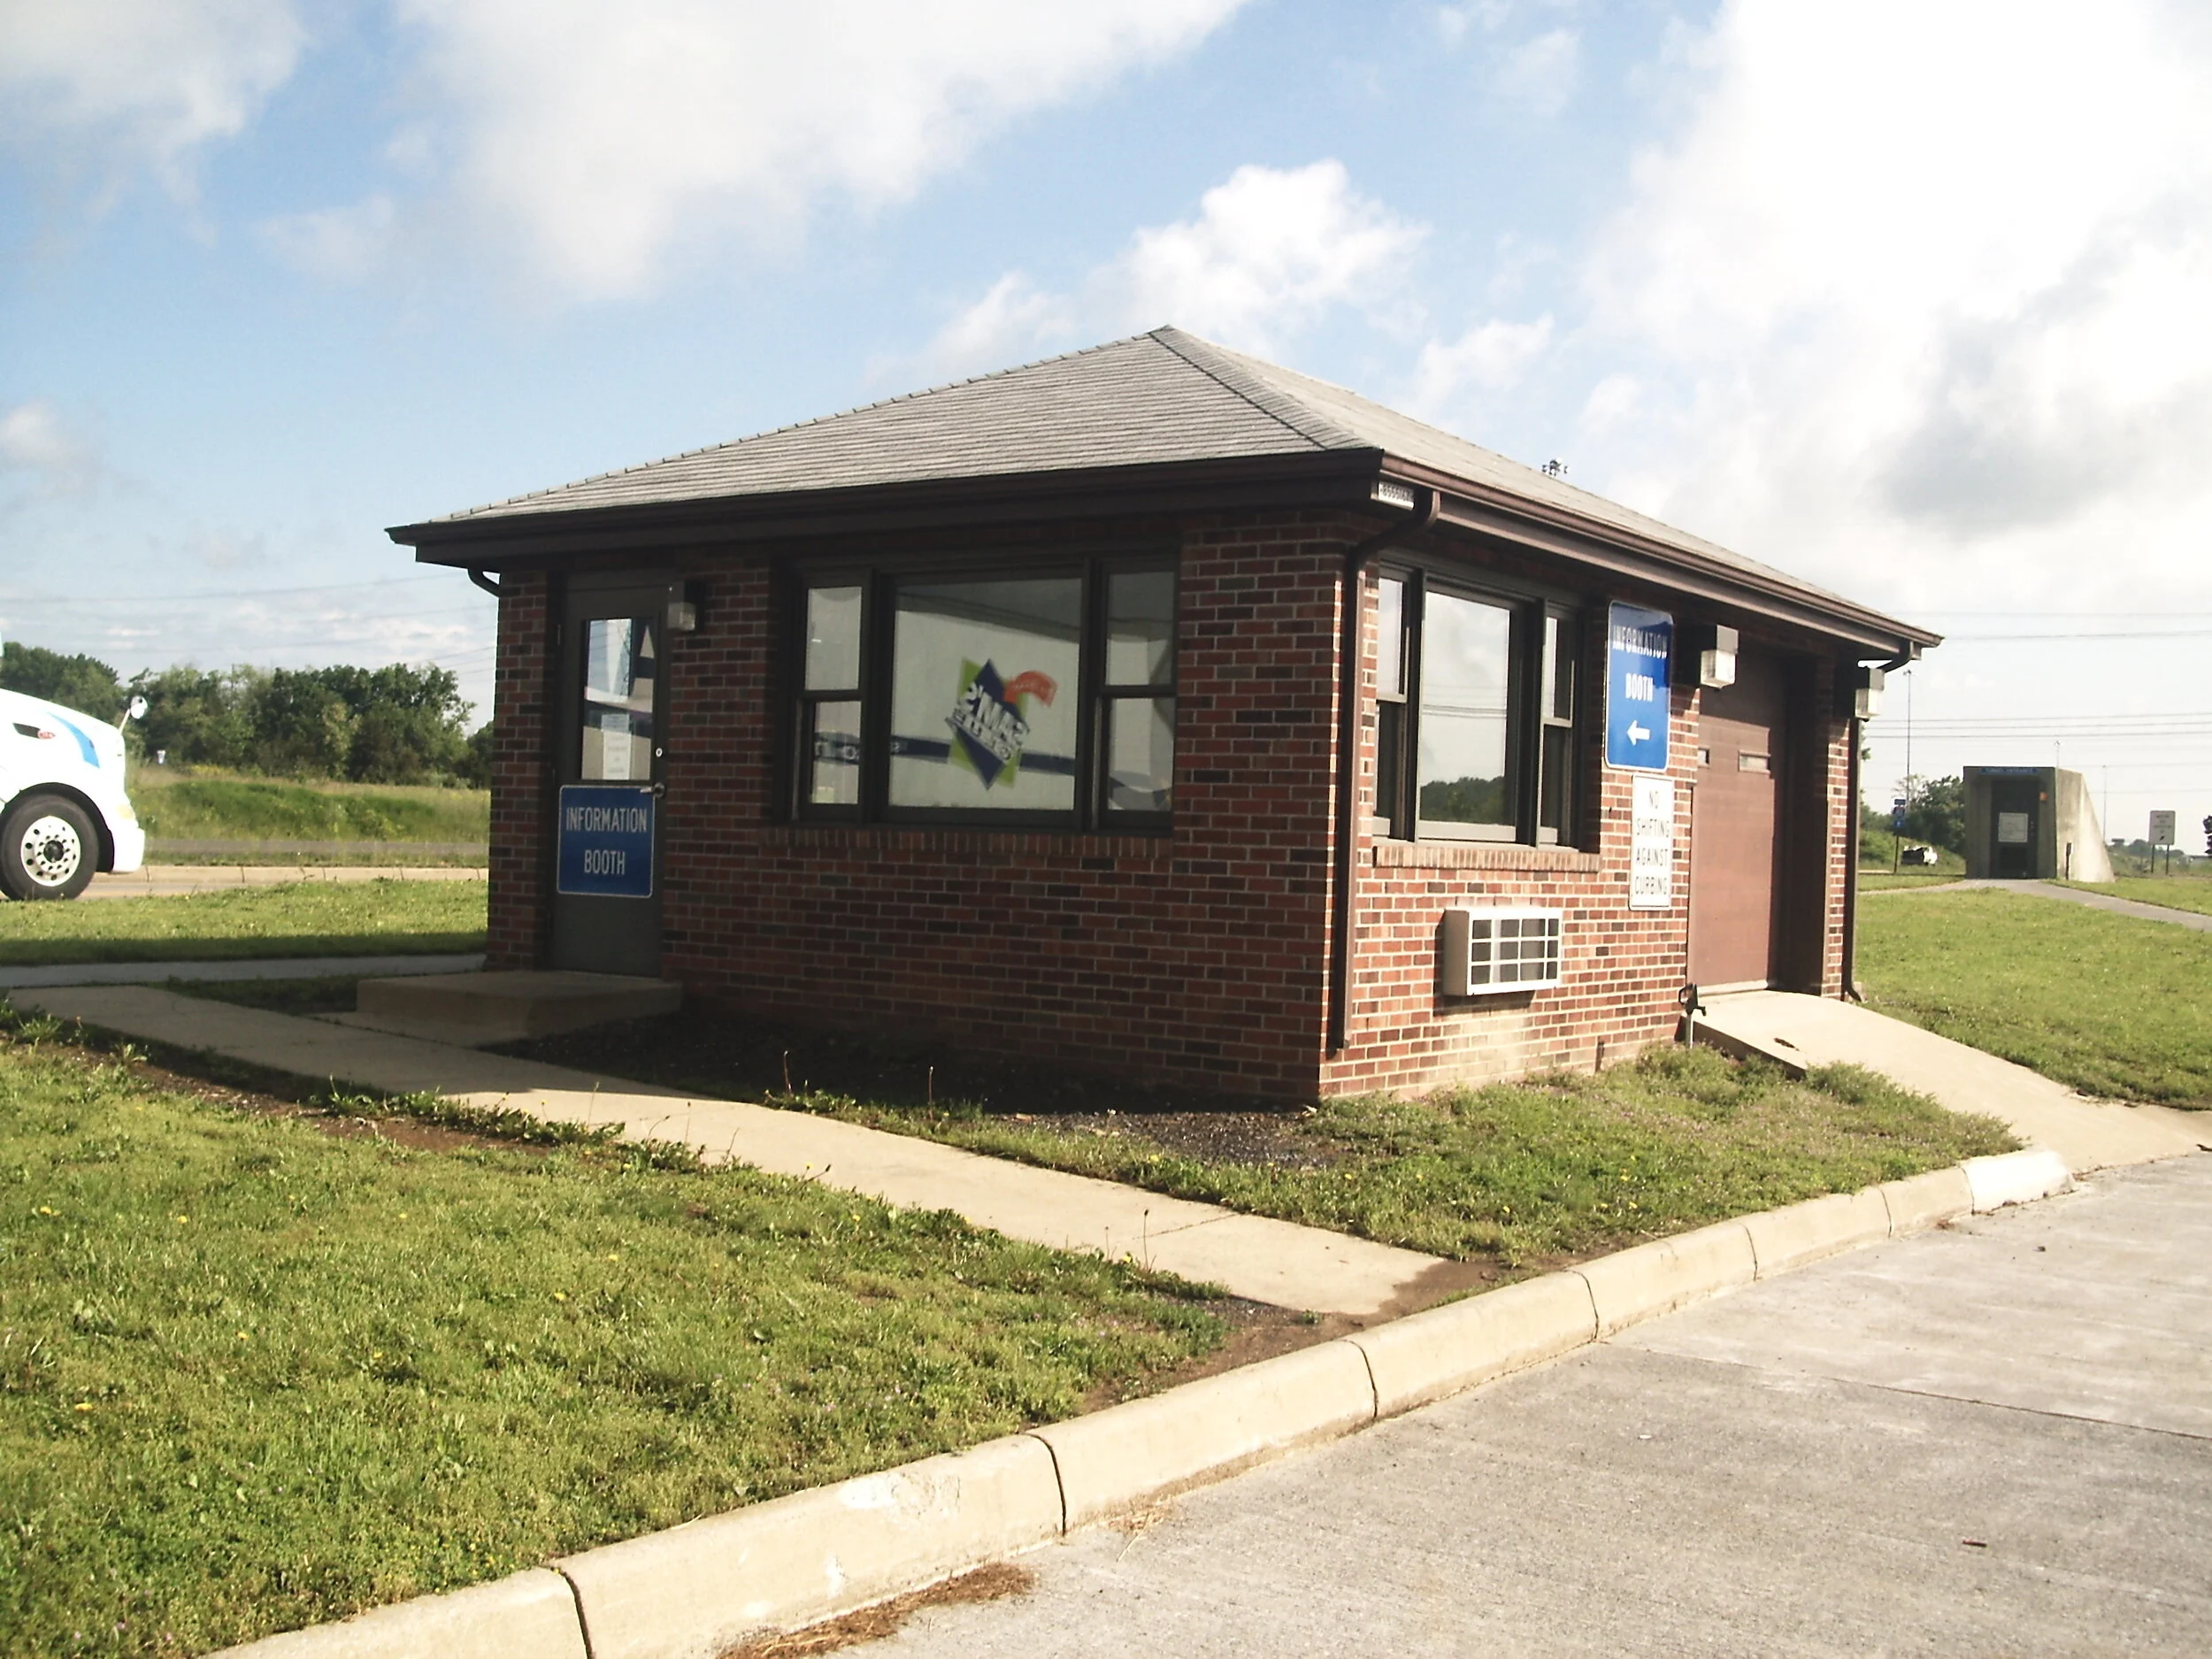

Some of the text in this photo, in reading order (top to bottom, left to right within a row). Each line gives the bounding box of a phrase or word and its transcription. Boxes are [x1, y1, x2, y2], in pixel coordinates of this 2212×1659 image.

[1612, 625, 1668, 659] INFORMATION
[1625, 672, 1654, 702] BOOTH
[1648, 790, 1661, 810] NO
[565, 806, 648, 833] INFORMATION
[1636, 818, 1671, 838] SHIFTING
[584, 849, 626, 875] BOOTH
[1635, 847, 1669, 867] AGAINST
[1634, 876, 1668, 895] CURBING
